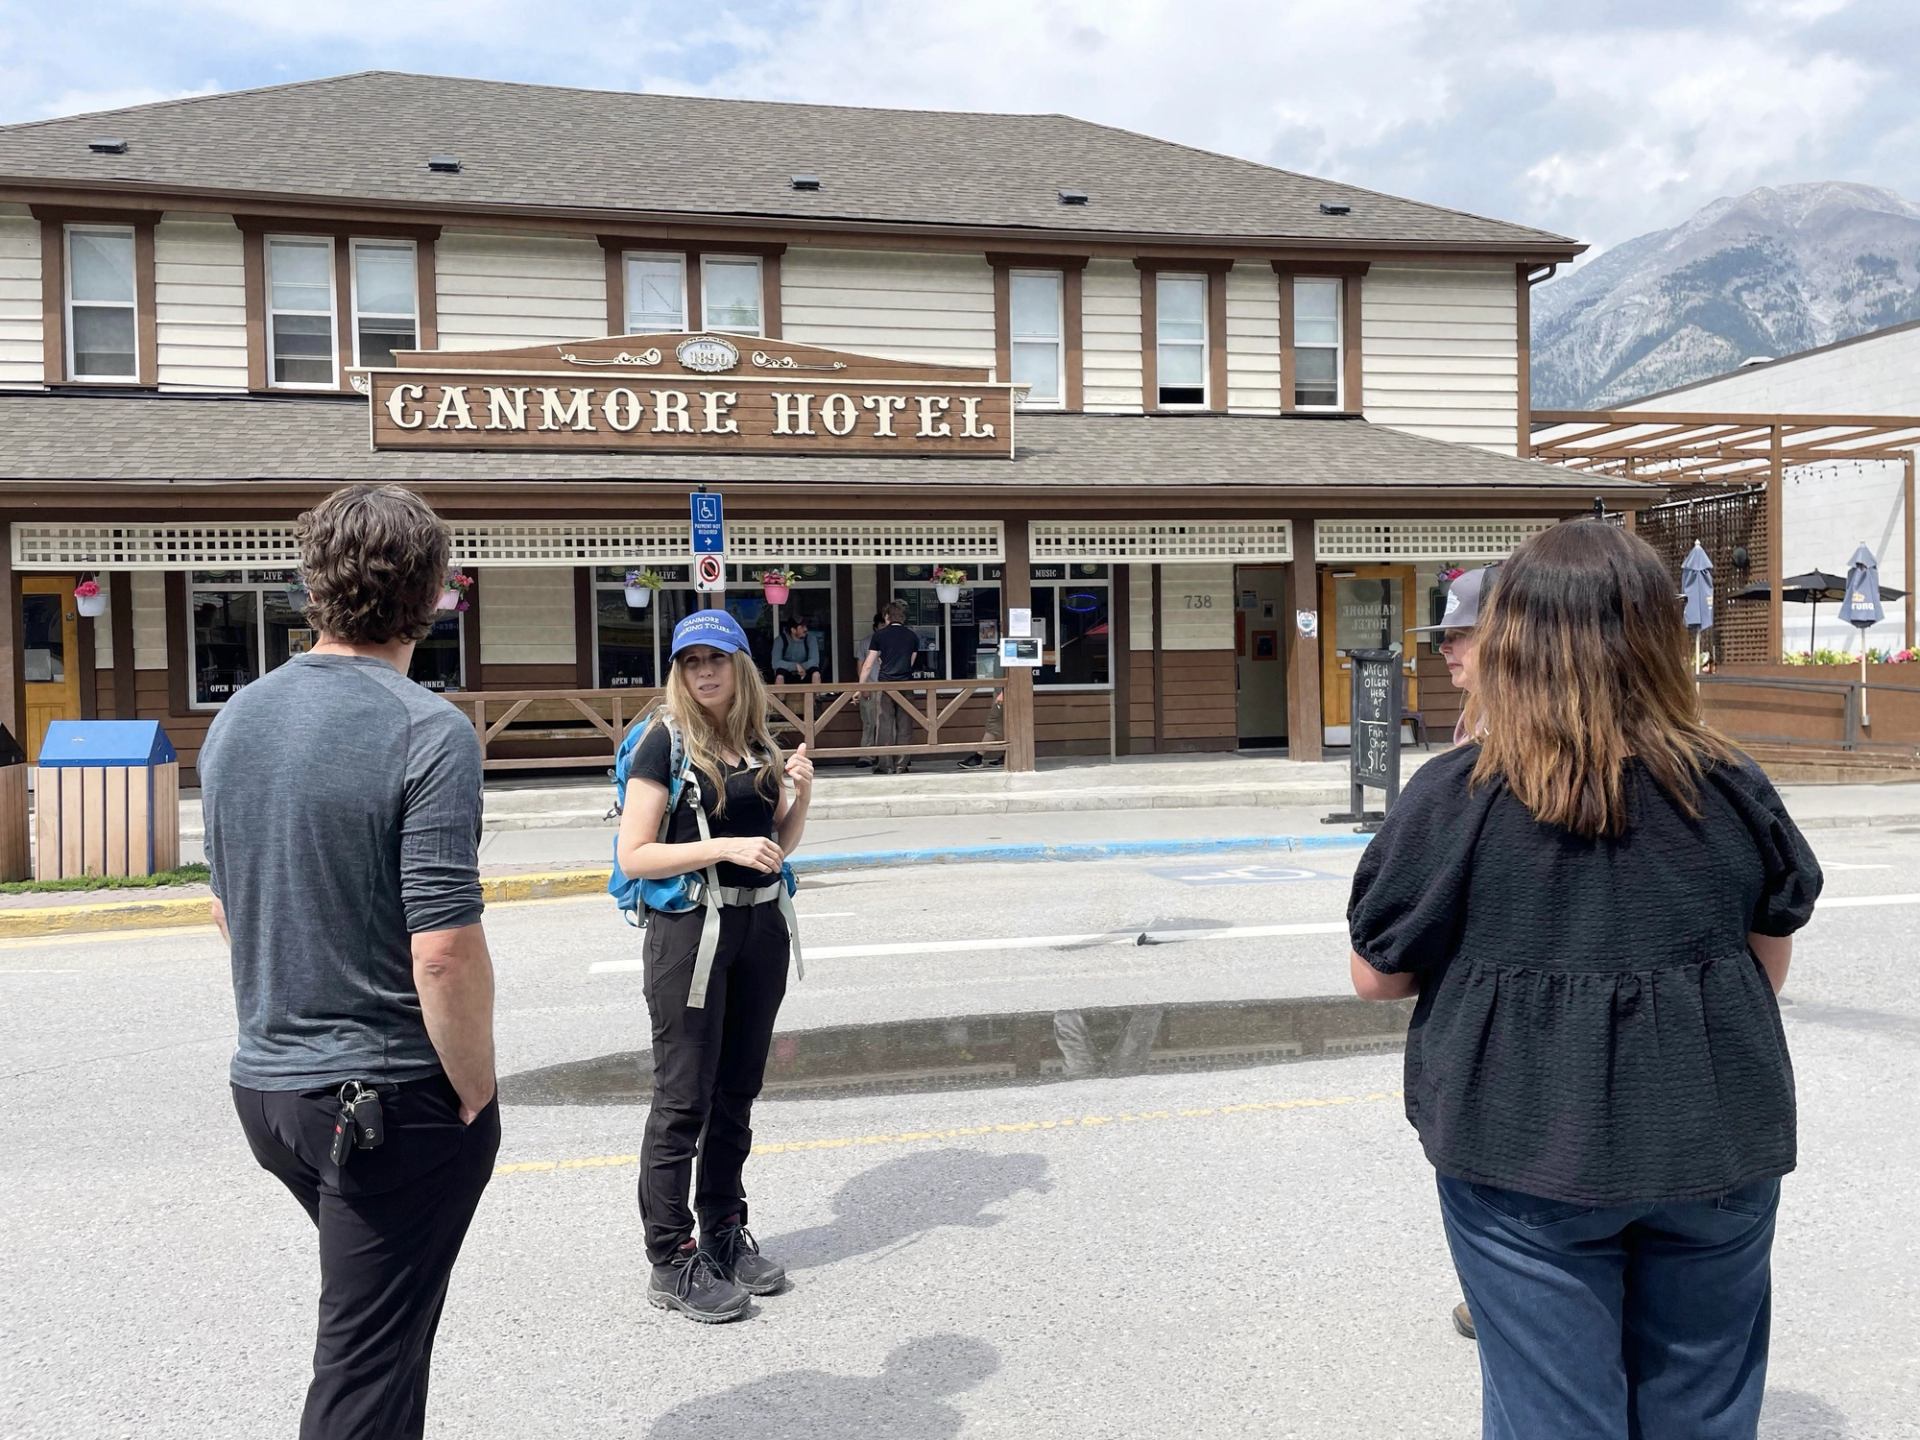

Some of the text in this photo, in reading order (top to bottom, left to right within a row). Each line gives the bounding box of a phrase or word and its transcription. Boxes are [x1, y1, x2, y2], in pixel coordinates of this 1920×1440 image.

[690, 352, 728, 366] 1890
[385, 383, 996, 439] CANMORE HOTEL
[263, 571, 283, 580] LIVE
[1035, 569, 1057, 578] MUSIC
[1183, 595, 1212, 609] 738
[683, 616, 720, 627] CANMORE
[1362, 663, 1389, 677] WATCH
[210, 684, 229, 692] OPEN
[1370, 688, 1387, 698] HERE
[1373, 697, 1383, 706] AT
[1374, 708, 1380, 718] 6
[1367, 750, 1387, 774] $16
